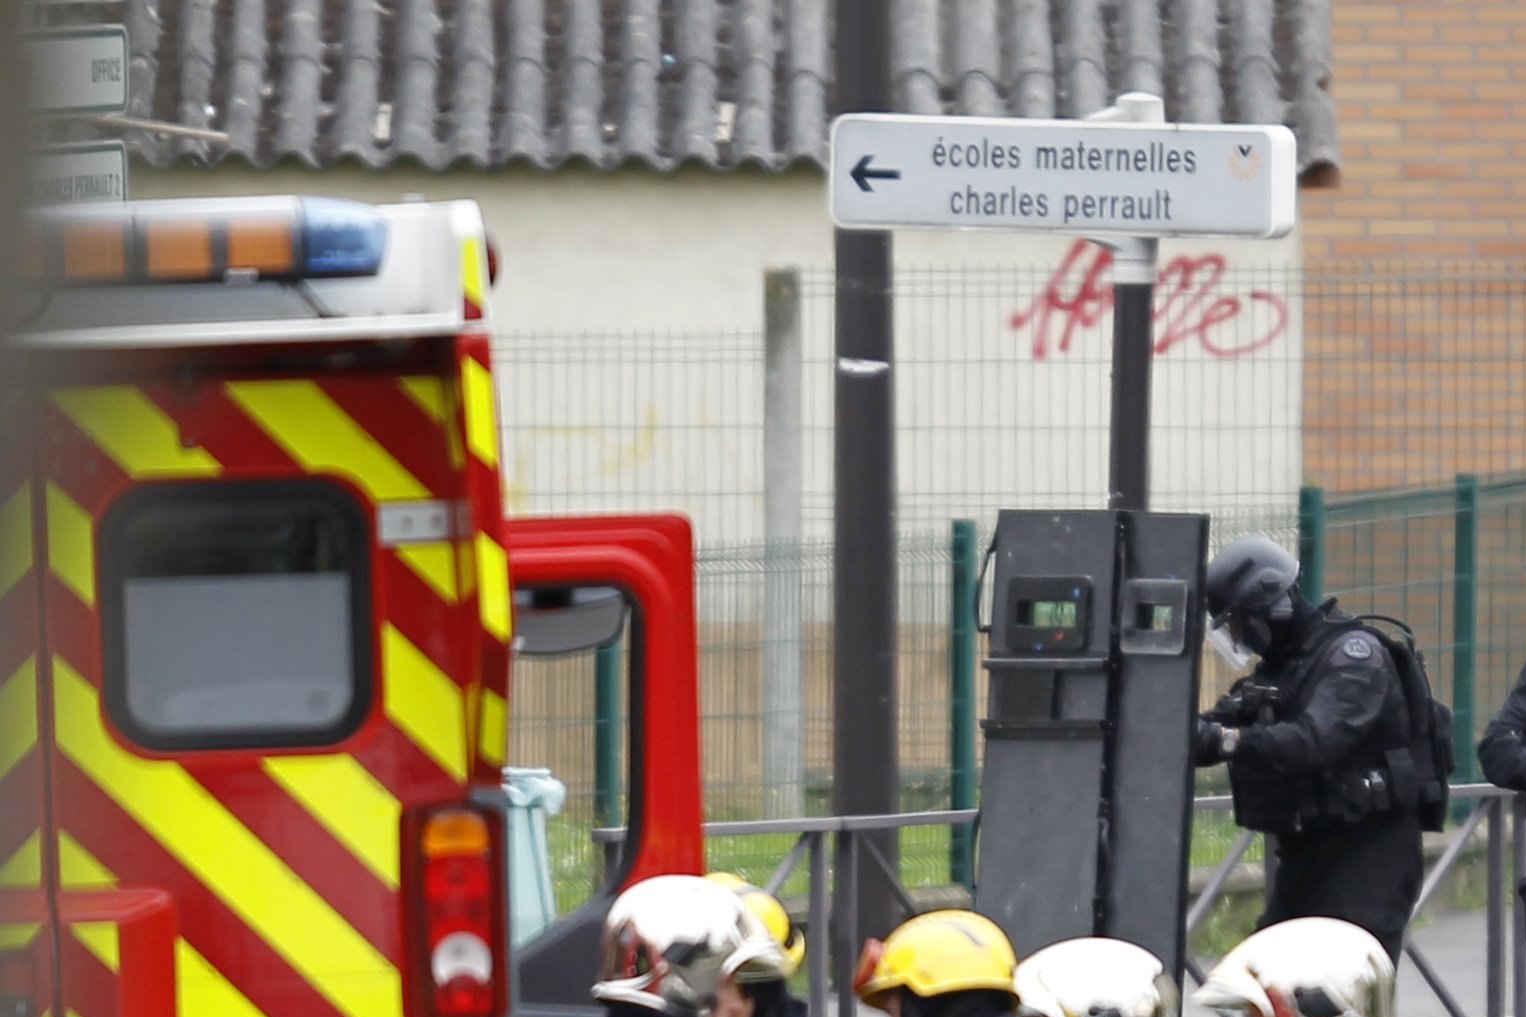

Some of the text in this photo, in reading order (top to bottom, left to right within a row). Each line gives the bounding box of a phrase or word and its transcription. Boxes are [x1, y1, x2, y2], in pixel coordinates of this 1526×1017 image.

[91, 59, 121, 82] OFFICE
[932, 136, 1197, 173] écoles maternelles
[949, 185, 1173, 223] charles perrault
